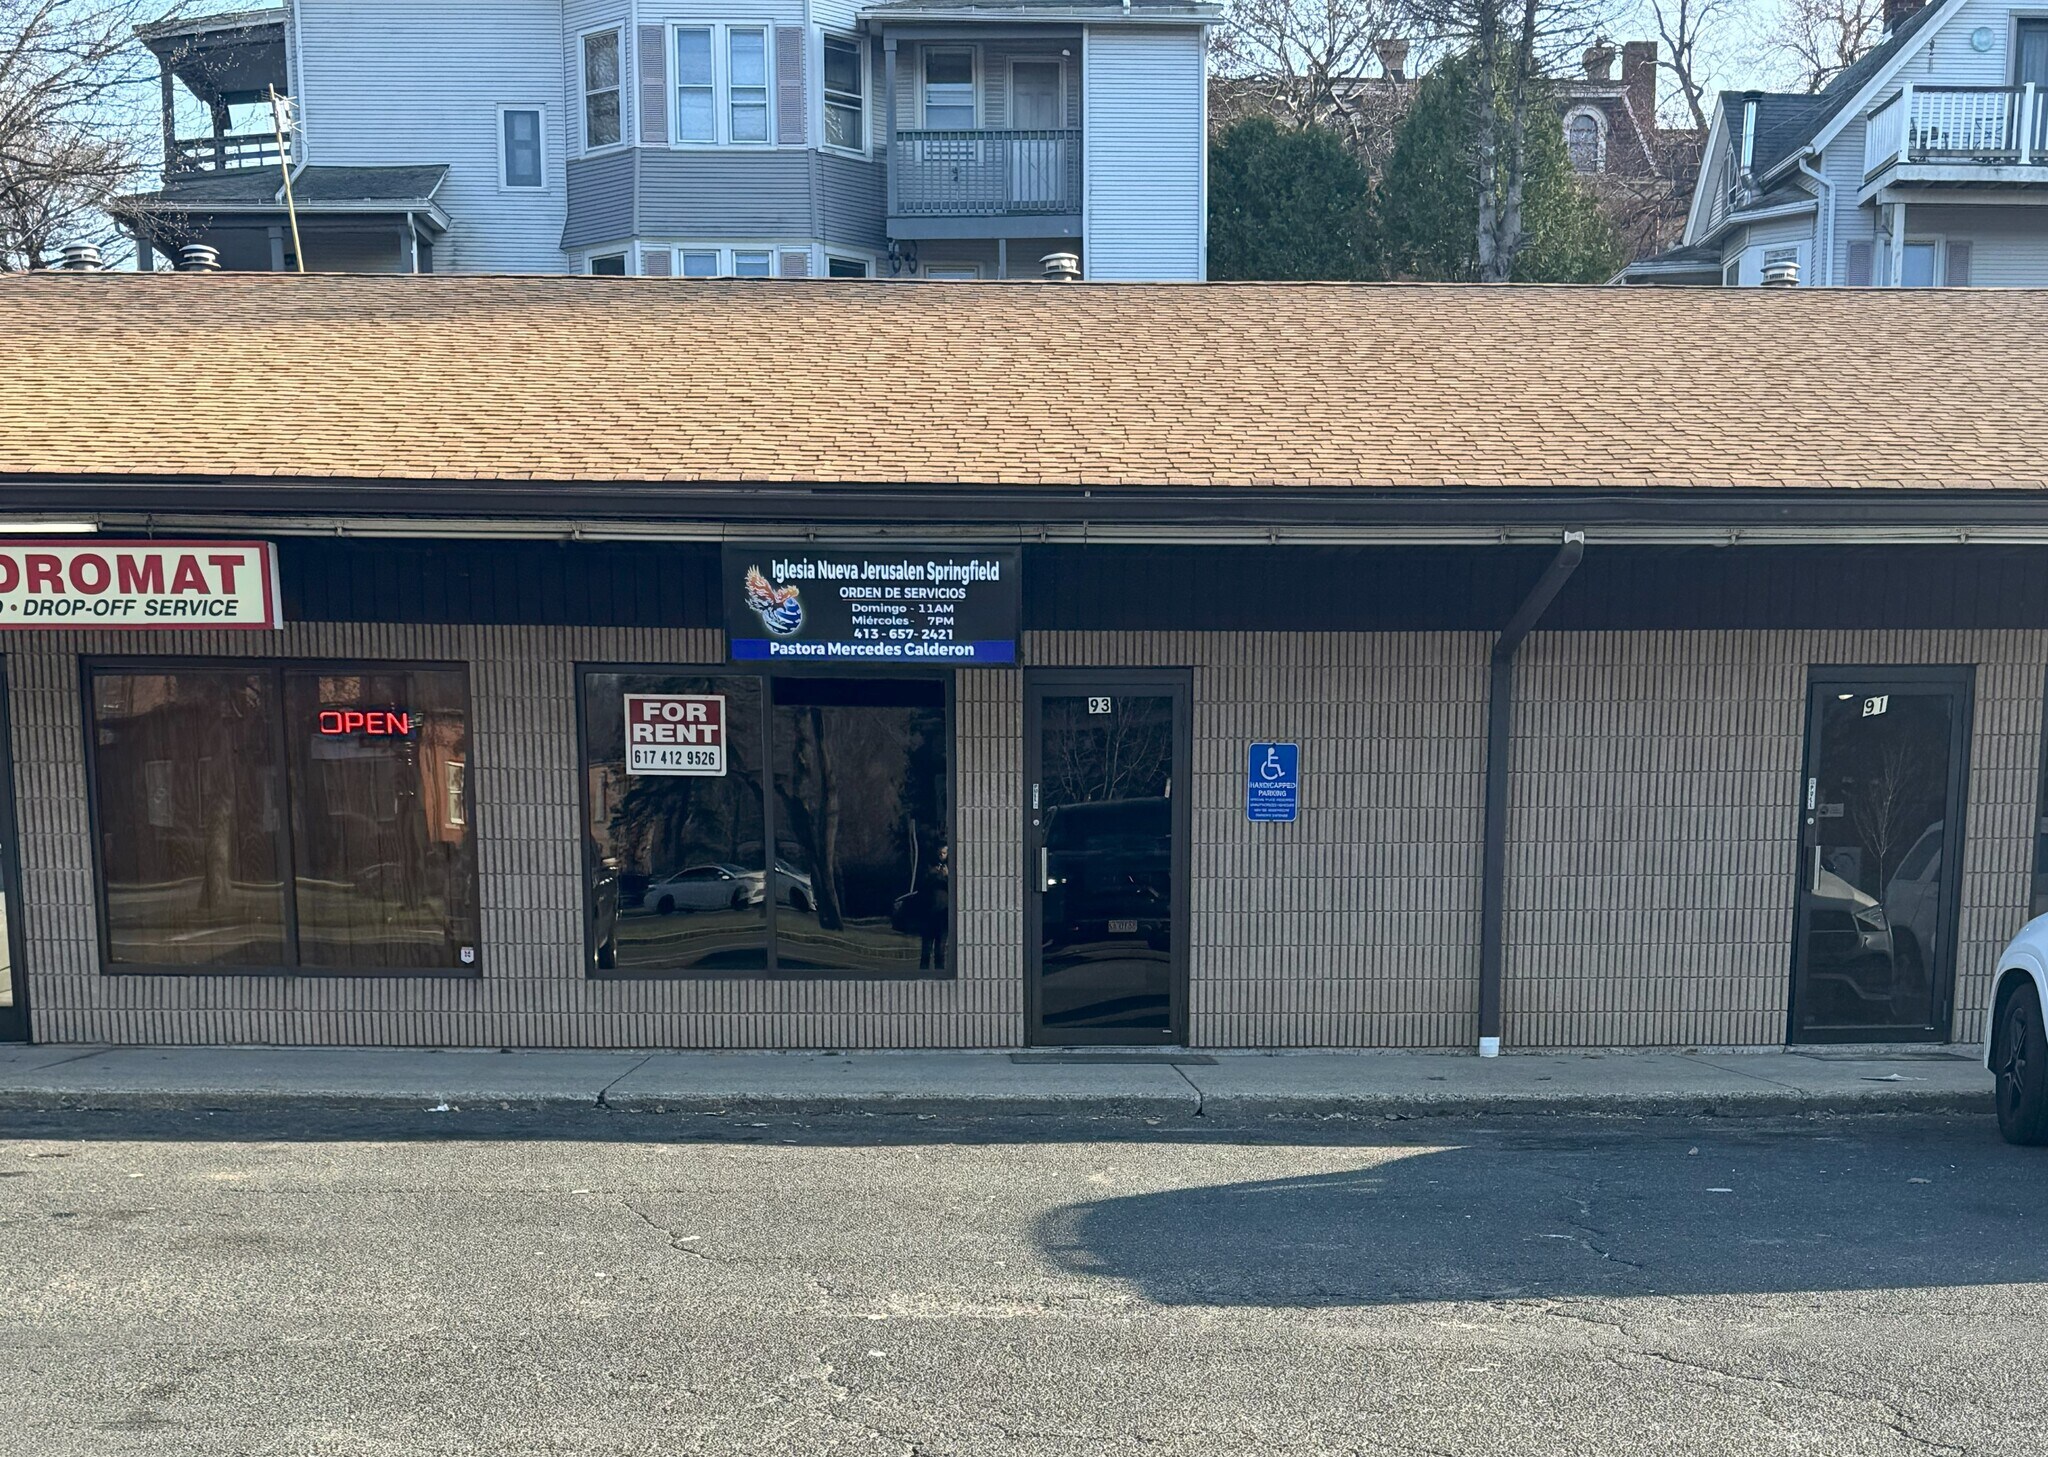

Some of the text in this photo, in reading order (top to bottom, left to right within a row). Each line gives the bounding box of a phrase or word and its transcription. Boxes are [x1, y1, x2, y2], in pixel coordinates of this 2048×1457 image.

[772, 558, 1000, 585] Iglesia Nueva Jerusalen Springfield
[839, 587, 966, 599] ORDEN DE SERVICIOS
[23, 599, 137, 617] DROP-OFF
[144, 599, 239, 617] SERVICE
[851, 603, 907, 615] Domingo
[919, 604, 954, 613] 11AM
[927, 616, 954, 626] 7PM
[770, 642, 975, 656] Pastora Mercedes Calderon
[642, 702, 707, 722] FOR
[1090, 699, 1110, 712] 93
[1865, 697, 1885, 714] 91
[320, 711, 408, 734] OPEN
[633, 724, 718, 743] RENT
[634, 750, 715, 766] 617 412 9526
